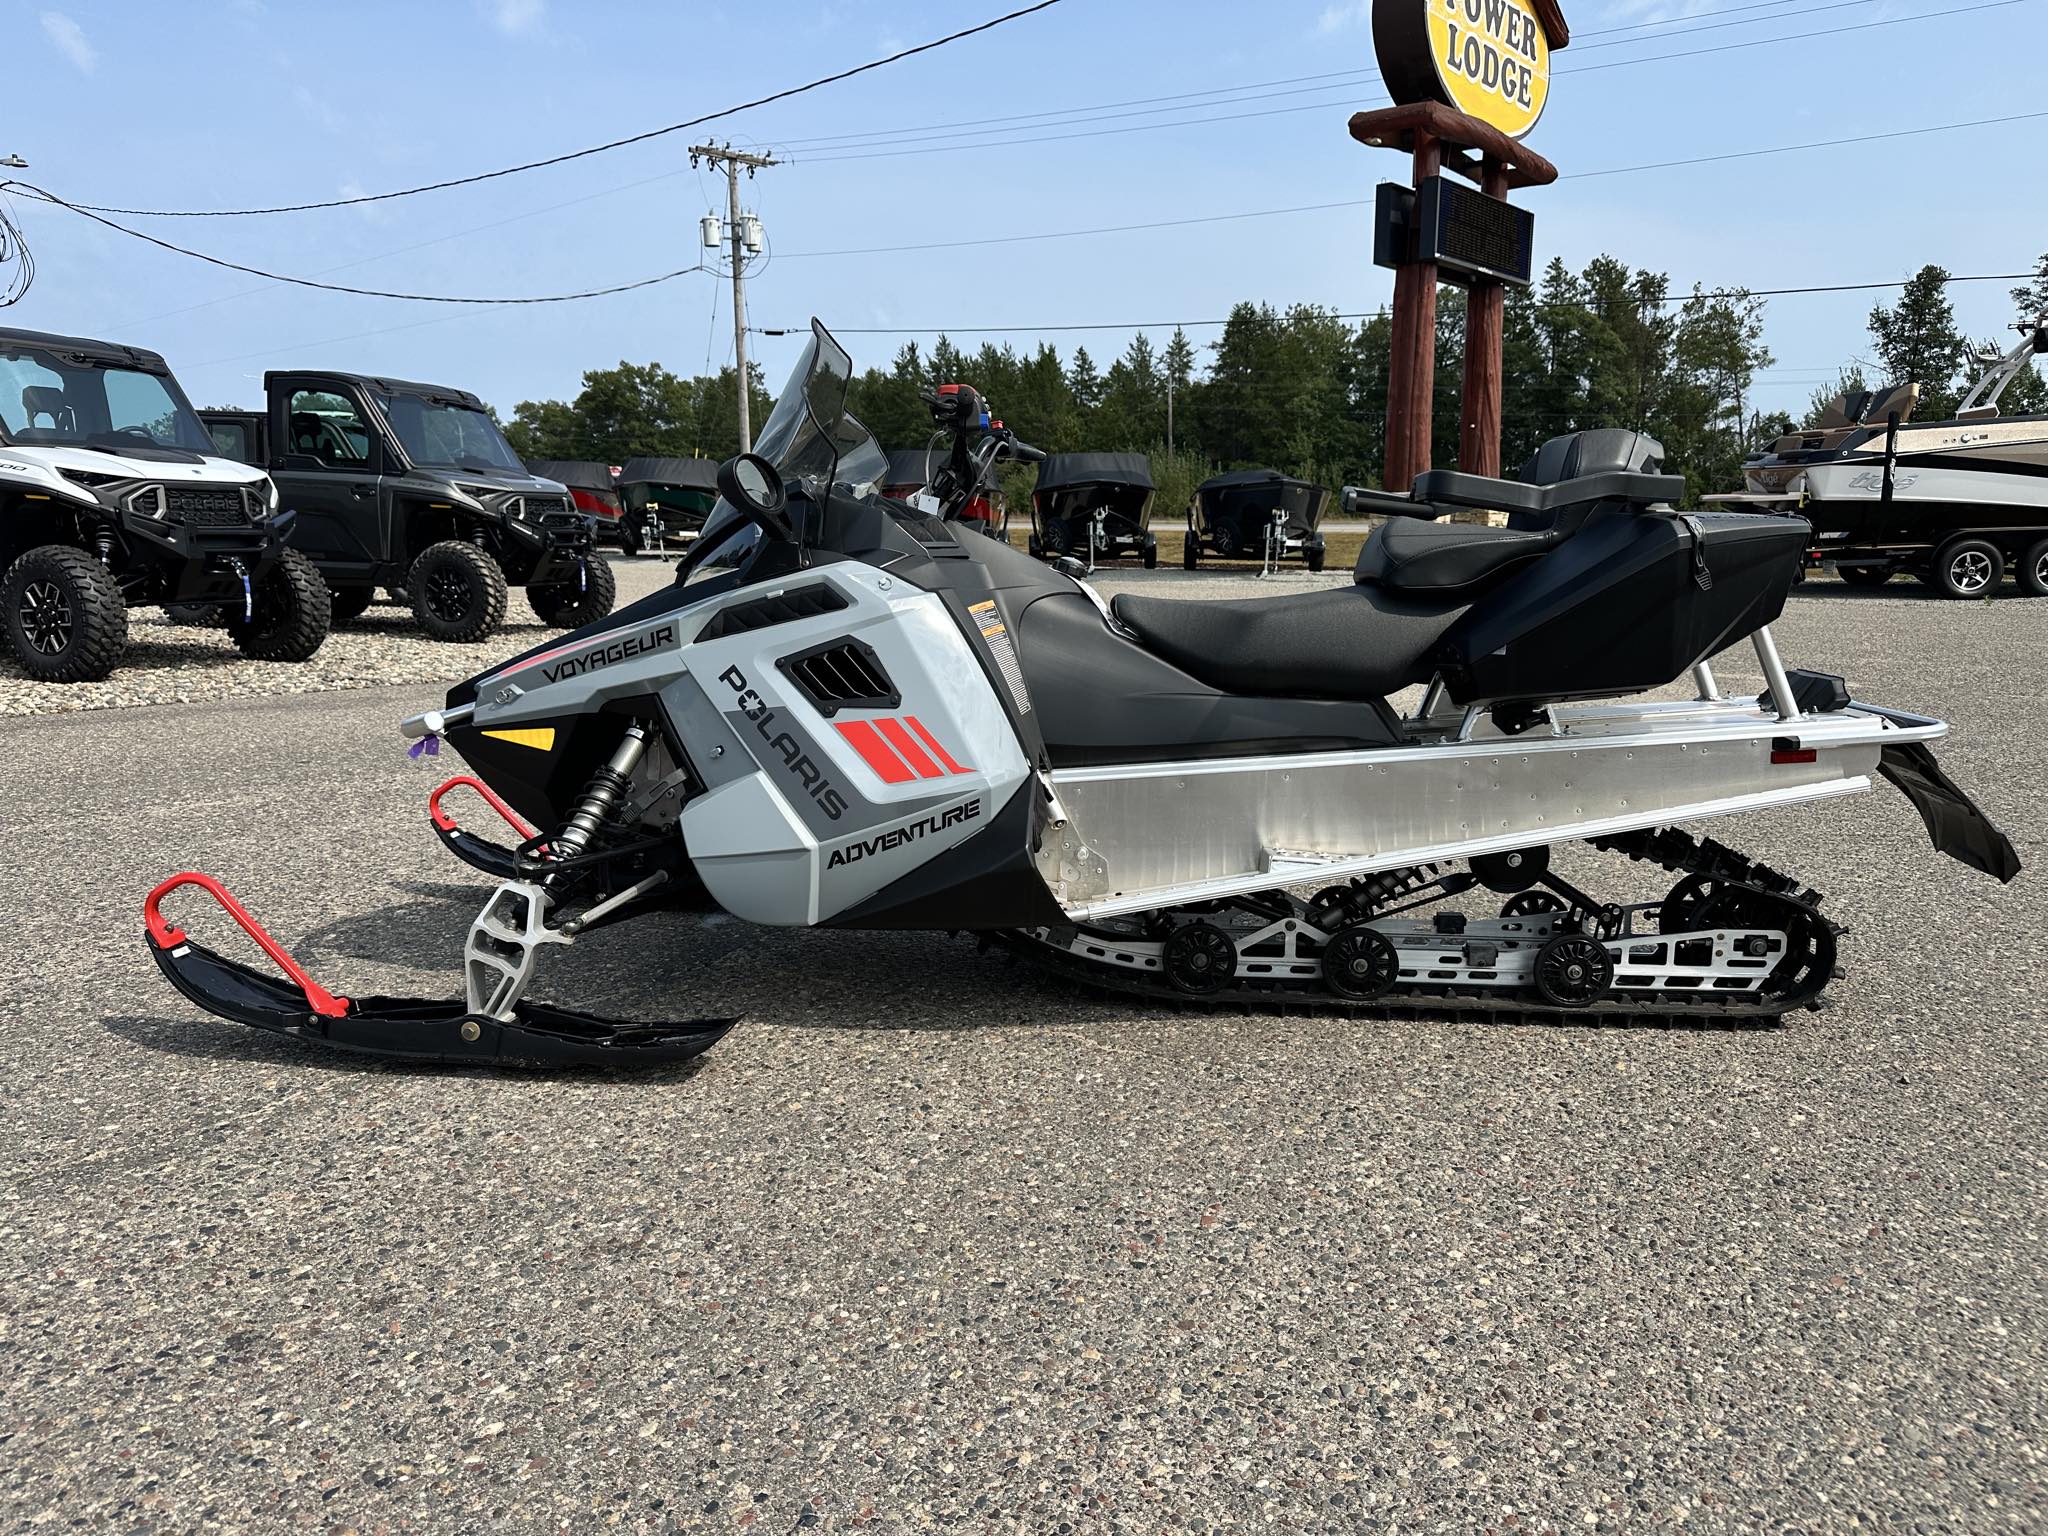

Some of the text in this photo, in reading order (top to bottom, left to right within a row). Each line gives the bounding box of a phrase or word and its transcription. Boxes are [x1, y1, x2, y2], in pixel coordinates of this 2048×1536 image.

[1447, 0, 1536, 61] OWER
[1448, 24, 1531, 108] LODGE
[169, 498, 240, 510] POLARIS
[542, 626, 674, 683] VOYAGEUR
[718, 664, 848, 820] POLARIS
[827, 799, 980, 869] ADVENTURE
